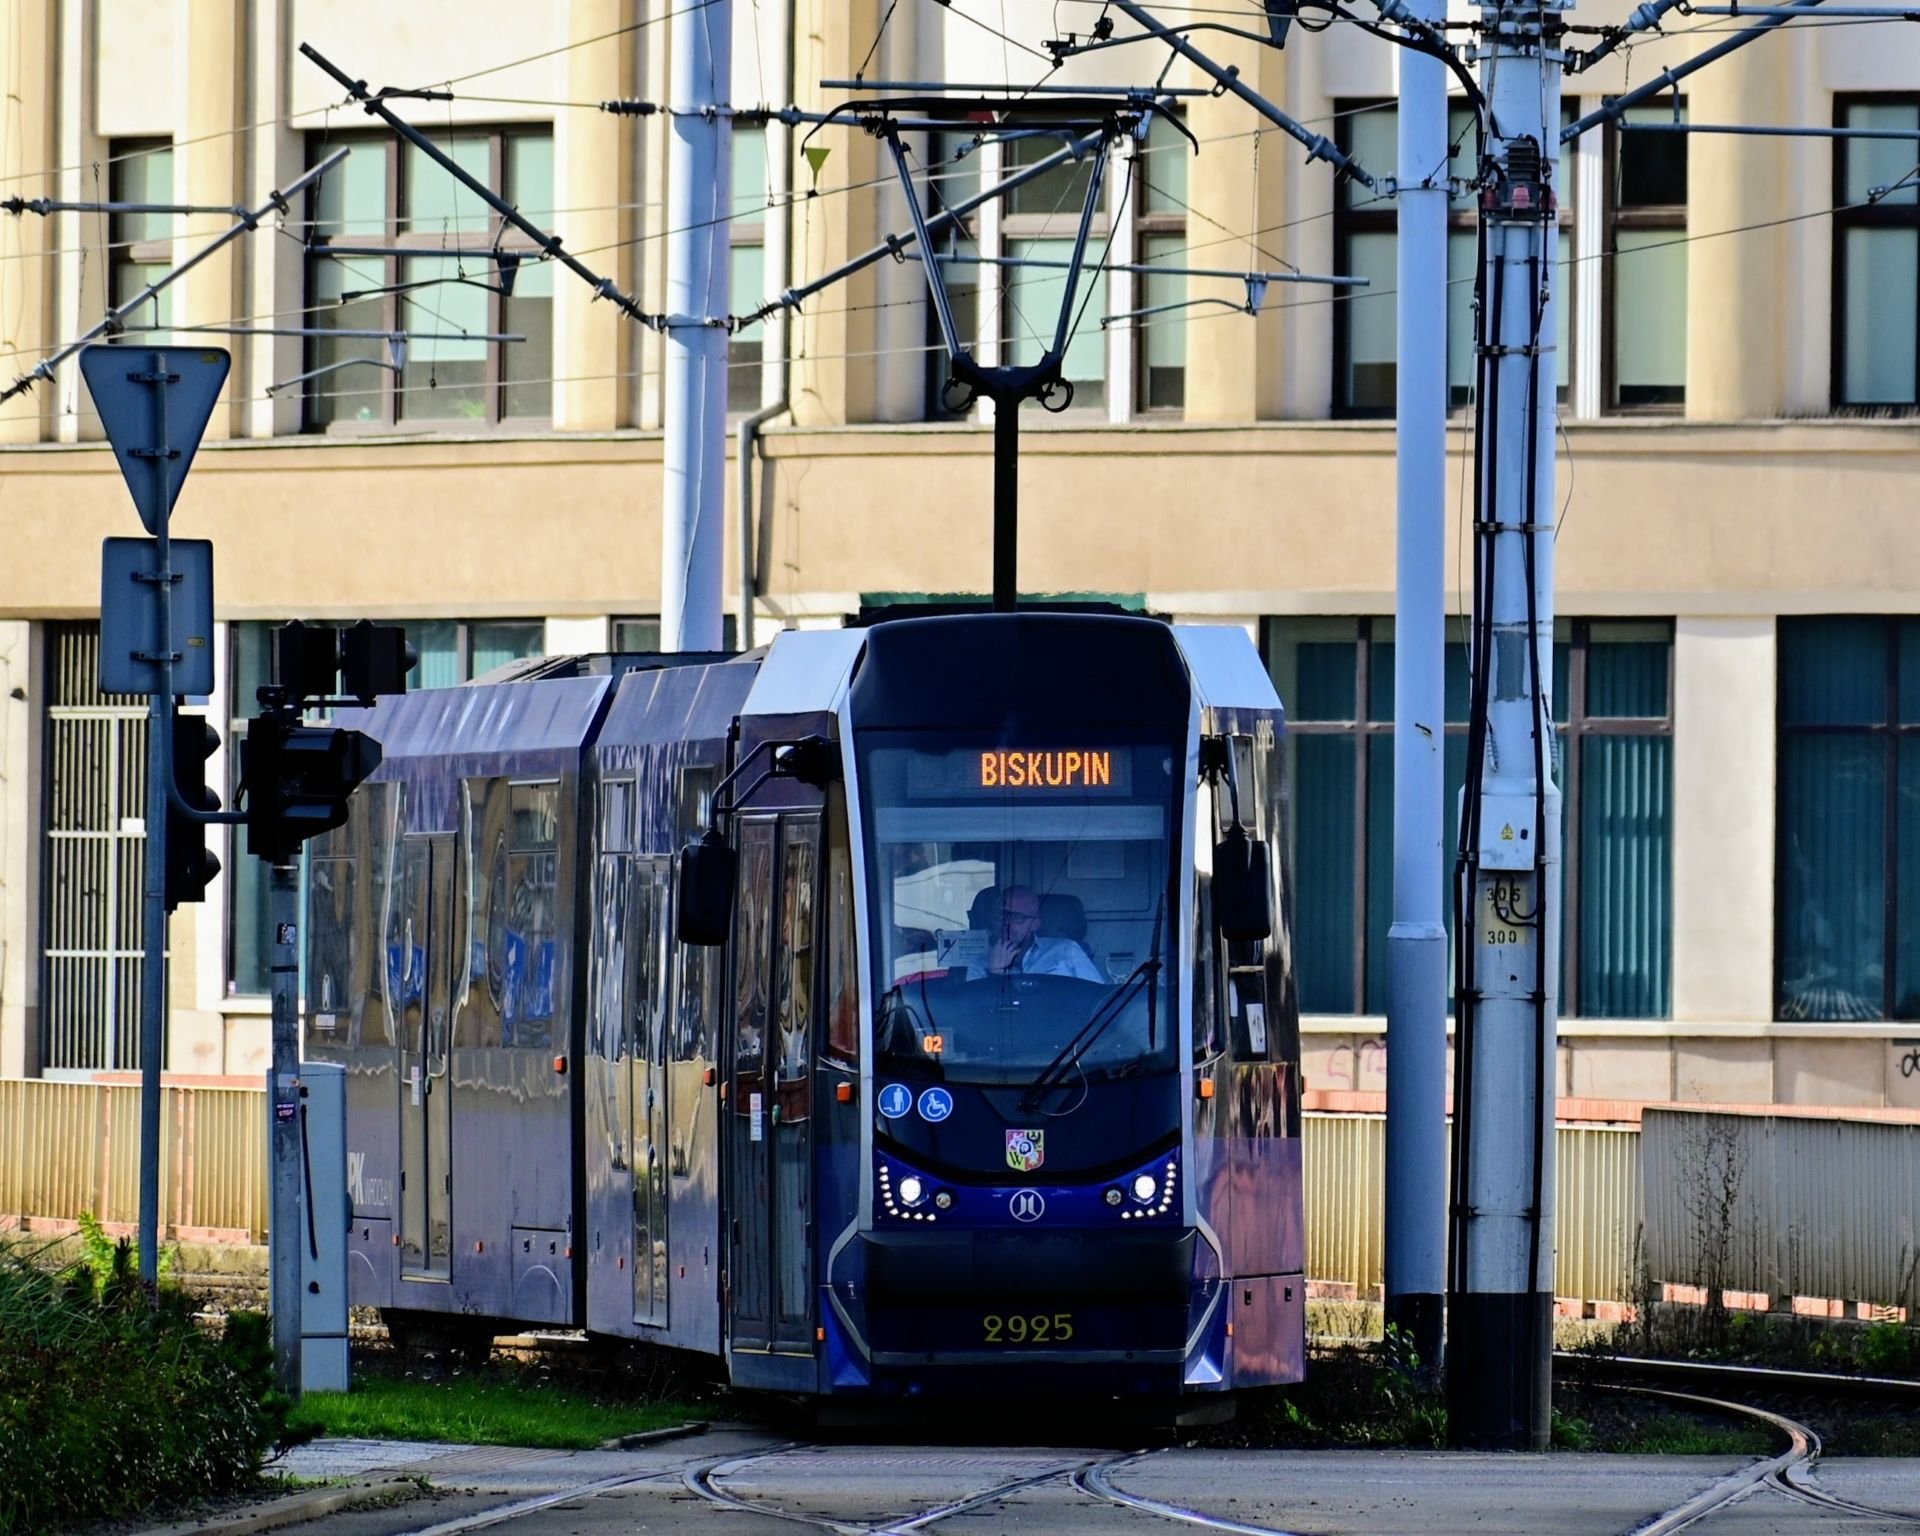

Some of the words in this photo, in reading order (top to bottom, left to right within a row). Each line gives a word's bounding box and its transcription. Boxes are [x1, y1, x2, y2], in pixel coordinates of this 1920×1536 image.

[981, 752, 1110, 786] BISKUPIN
[1488, 930, 1517, 944] 300
[924, 1035, 942, 1053] 02
[347, 1152, 365, 1204] PK
[983, 1313, 1073, 1342] 2925
